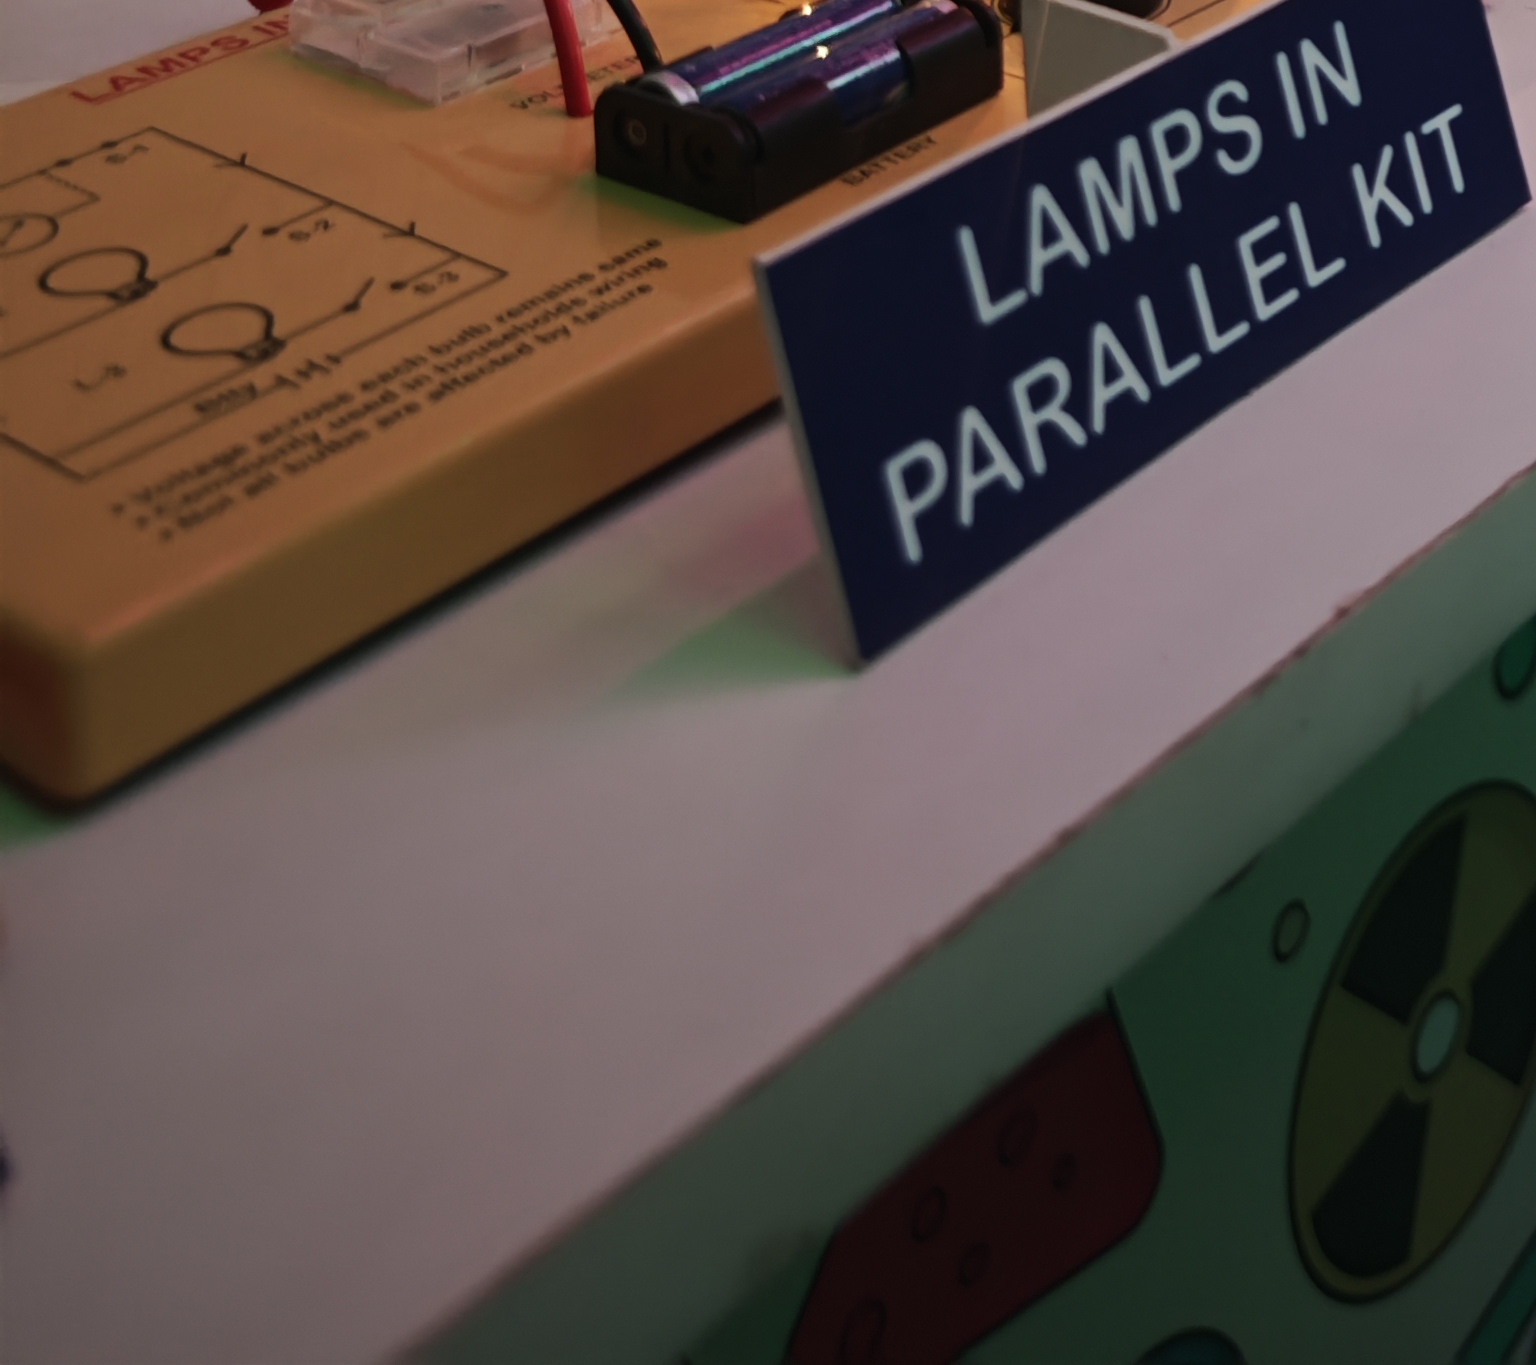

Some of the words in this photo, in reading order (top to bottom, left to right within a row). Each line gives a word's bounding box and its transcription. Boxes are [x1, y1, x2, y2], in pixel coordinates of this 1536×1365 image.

[69, 33, 250, 106] LAMPS
[841, 134, 939, 188] BATTERY
[957, 78, 1265, 327] LAMPS
[1275, 18, 1364, 139] IN
[882, 195, 1347, 565] PARALLEL
[1351, 103, 1467, 250] KIT
